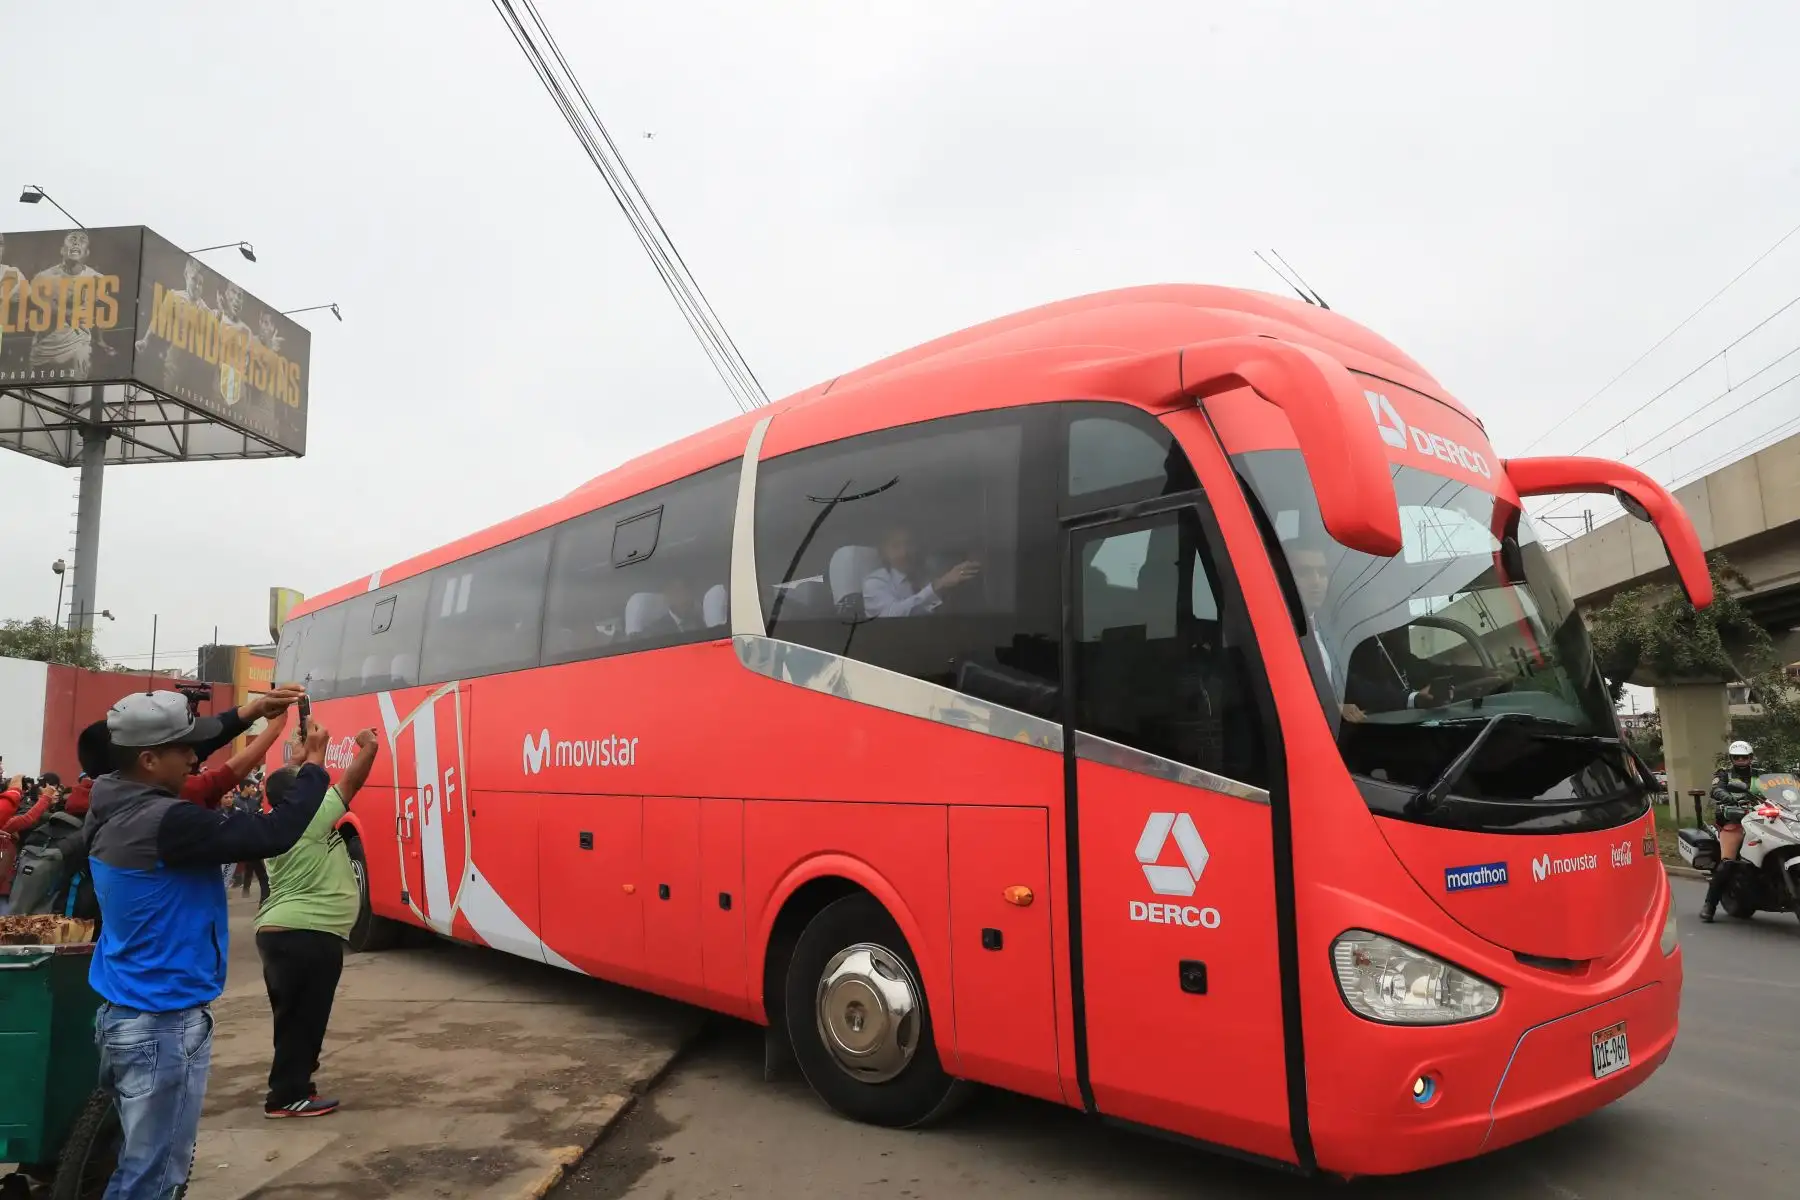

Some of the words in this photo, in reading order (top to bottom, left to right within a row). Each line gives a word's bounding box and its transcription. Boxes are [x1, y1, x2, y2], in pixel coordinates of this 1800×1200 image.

[1408, 425, 1491, 480] DERCO
[555, 734, 639, 767] movistar
[1447, 866, 1507, 888] marathon
[1553, 853, 1598, 874] movistar
[1129, 900, 1221, 929] DERCO
